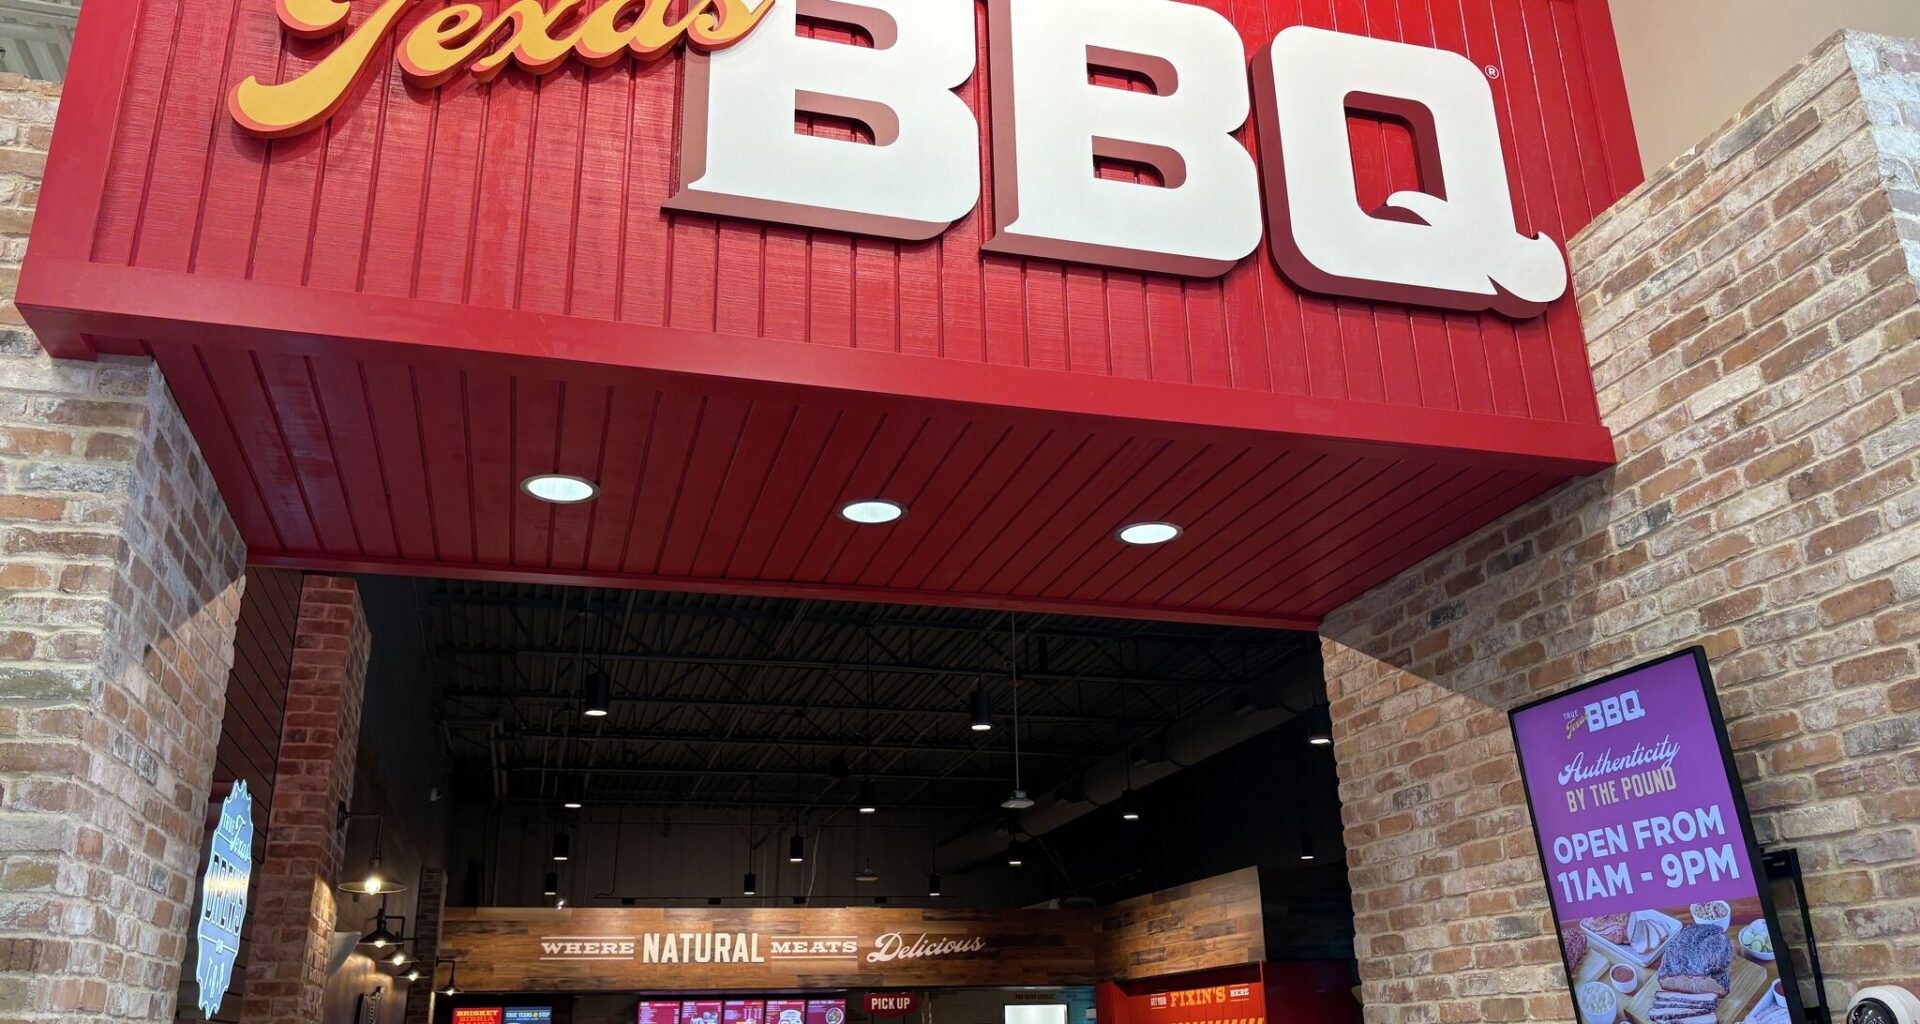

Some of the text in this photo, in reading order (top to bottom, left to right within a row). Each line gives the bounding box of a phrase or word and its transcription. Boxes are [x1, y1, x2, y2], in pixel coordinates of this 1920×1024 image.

[670, 0, 1568, 312] BBQ
[1563, 709, 1579, 720] TRUE
[1583, 690, 1646, 733] BBQ
[1558, 734, 1681, 786] Authenticity
[1566, 766, 1677, 813] BY THE POUND
[1553, 804, 1726, 864] OPEN FROM
[1557, 862, 1634, 903] 11AM
[1660, 843, 1740, 888] 9PM
[540, 931, 986, 964] WHERE NATURAL MEATS Delicious
[871, 997, 911, 1010] PICK UP
[1170, 986, 1226, 1008] FIXIN'S
